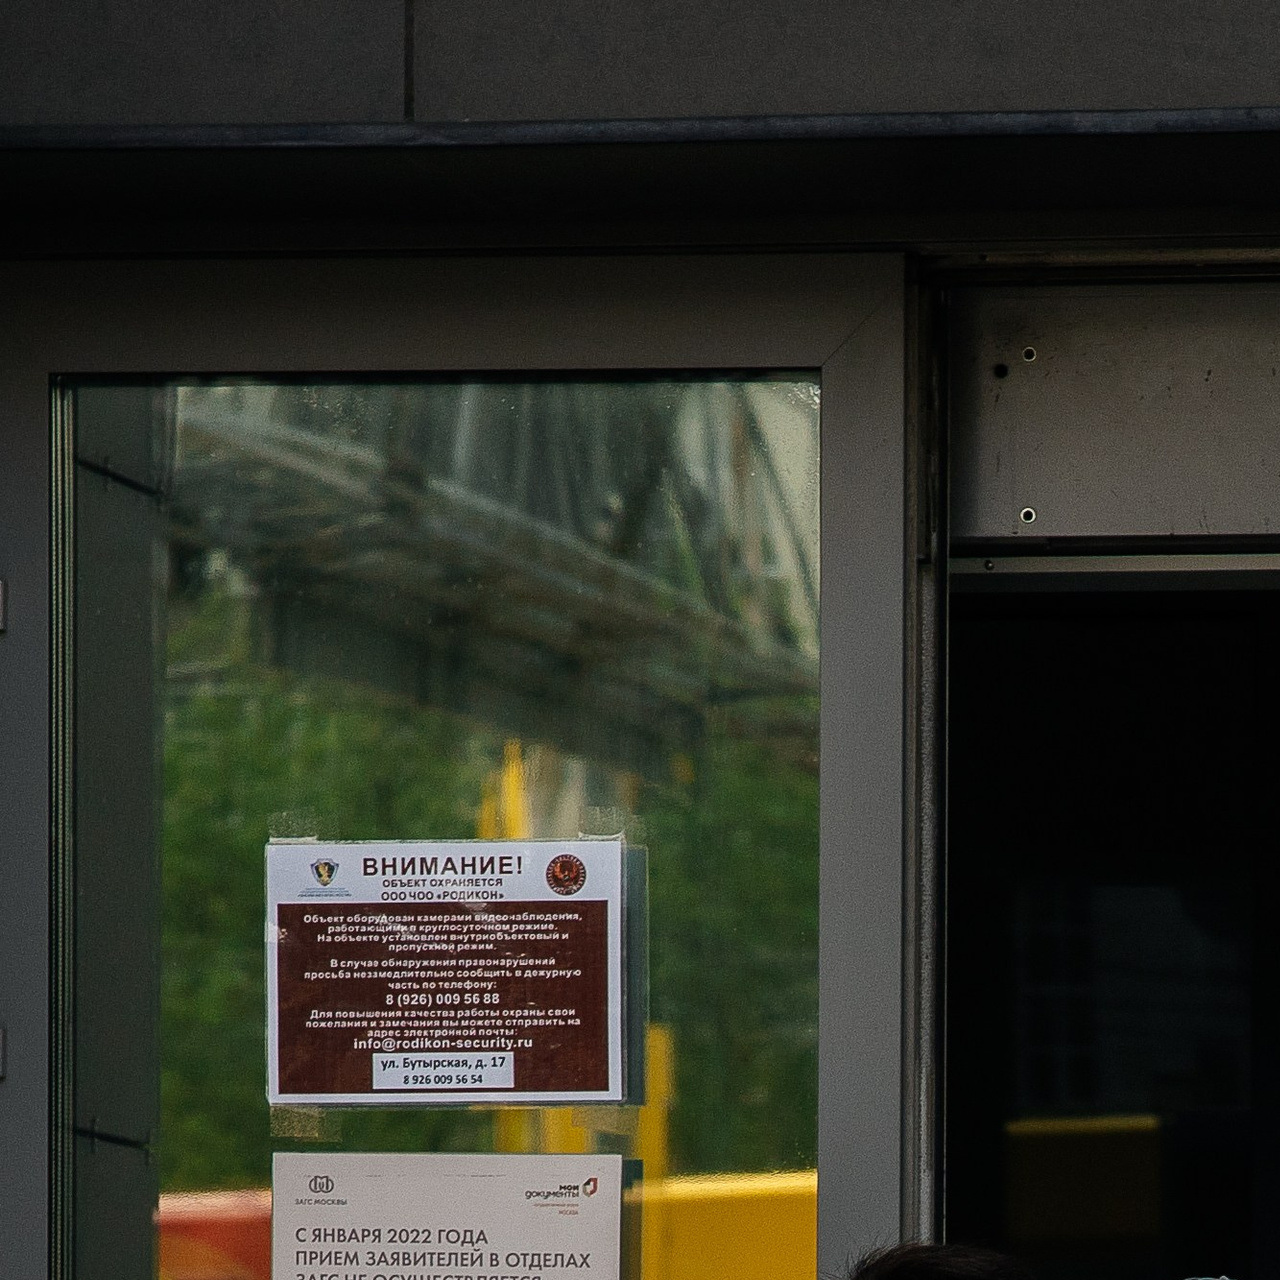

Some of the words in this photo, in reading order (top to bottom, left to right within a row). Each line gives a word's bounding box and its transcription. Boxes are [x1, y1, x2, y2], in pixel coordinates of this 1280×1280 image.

[363, 856, 523, 876] ВНИМАНИЕ!
[382, 879, 426, 888] ОБЪЕКТ
[429, 878, 503, 888] ОХРАНЯЕТСЯ
[381, 891, 407, 901] ООО
[408, 891, 434, 901] ЧОО
[436, 890, 505, 901] «РОДИКОН»
[304, 971, 351, 982] просьба
[353, 970, 455, 981] незамедлительно
[456, 968, 513, 979] сообщить
[523, 969, 582, 980] дежурную
[388, 982, 420, 990] часть
[438, 980, 498, 991] телефону:
[386, 994, 394, 1005] 8
[397, 994, 433, 1008] (926)
[436, 994, 460, 1005] 009
[464, 993, 480, 1005] 56
[483, 993, 500, 1004] 88
[367, 1029, 401, 1039] адрес
[403, 1027, 477, 1038] электронной
[479, 1028, 518, 1036] почты:
[353, 1037, 533, 1051] info@rodikon-security.ru
[381, 1060, 399, 1071] ул.
[403, 1057, 472, 1071] Бутырская,
[475, 1059, 488, 1069] д.
[491, 1057, 506, 1067] 17
[403, 1075, 410, 1085] 8
[412, 1075, 431, 1085] 926
[434, 1074, 453, 1084] 009
[456, 1074, 468, 1084] 56
[471, 1074, 483, 1084] 54
[295, 1228, 307, 1243] С
[312, 1228, 381, 1244] ЯНВАРЯ
[387, 1229, 432, 1244] 2022
[438, 1230, 488, 1246] ГОДА
[296, 1251, 359, 1267] ПРИЕМ
[366, 1248, 483, 1268] ЗАЯВИТЕЛЕЙ
[490, 1253, 499, 1267] В
[505, 1253, 591, 1270] ОТДЕЛАХ
